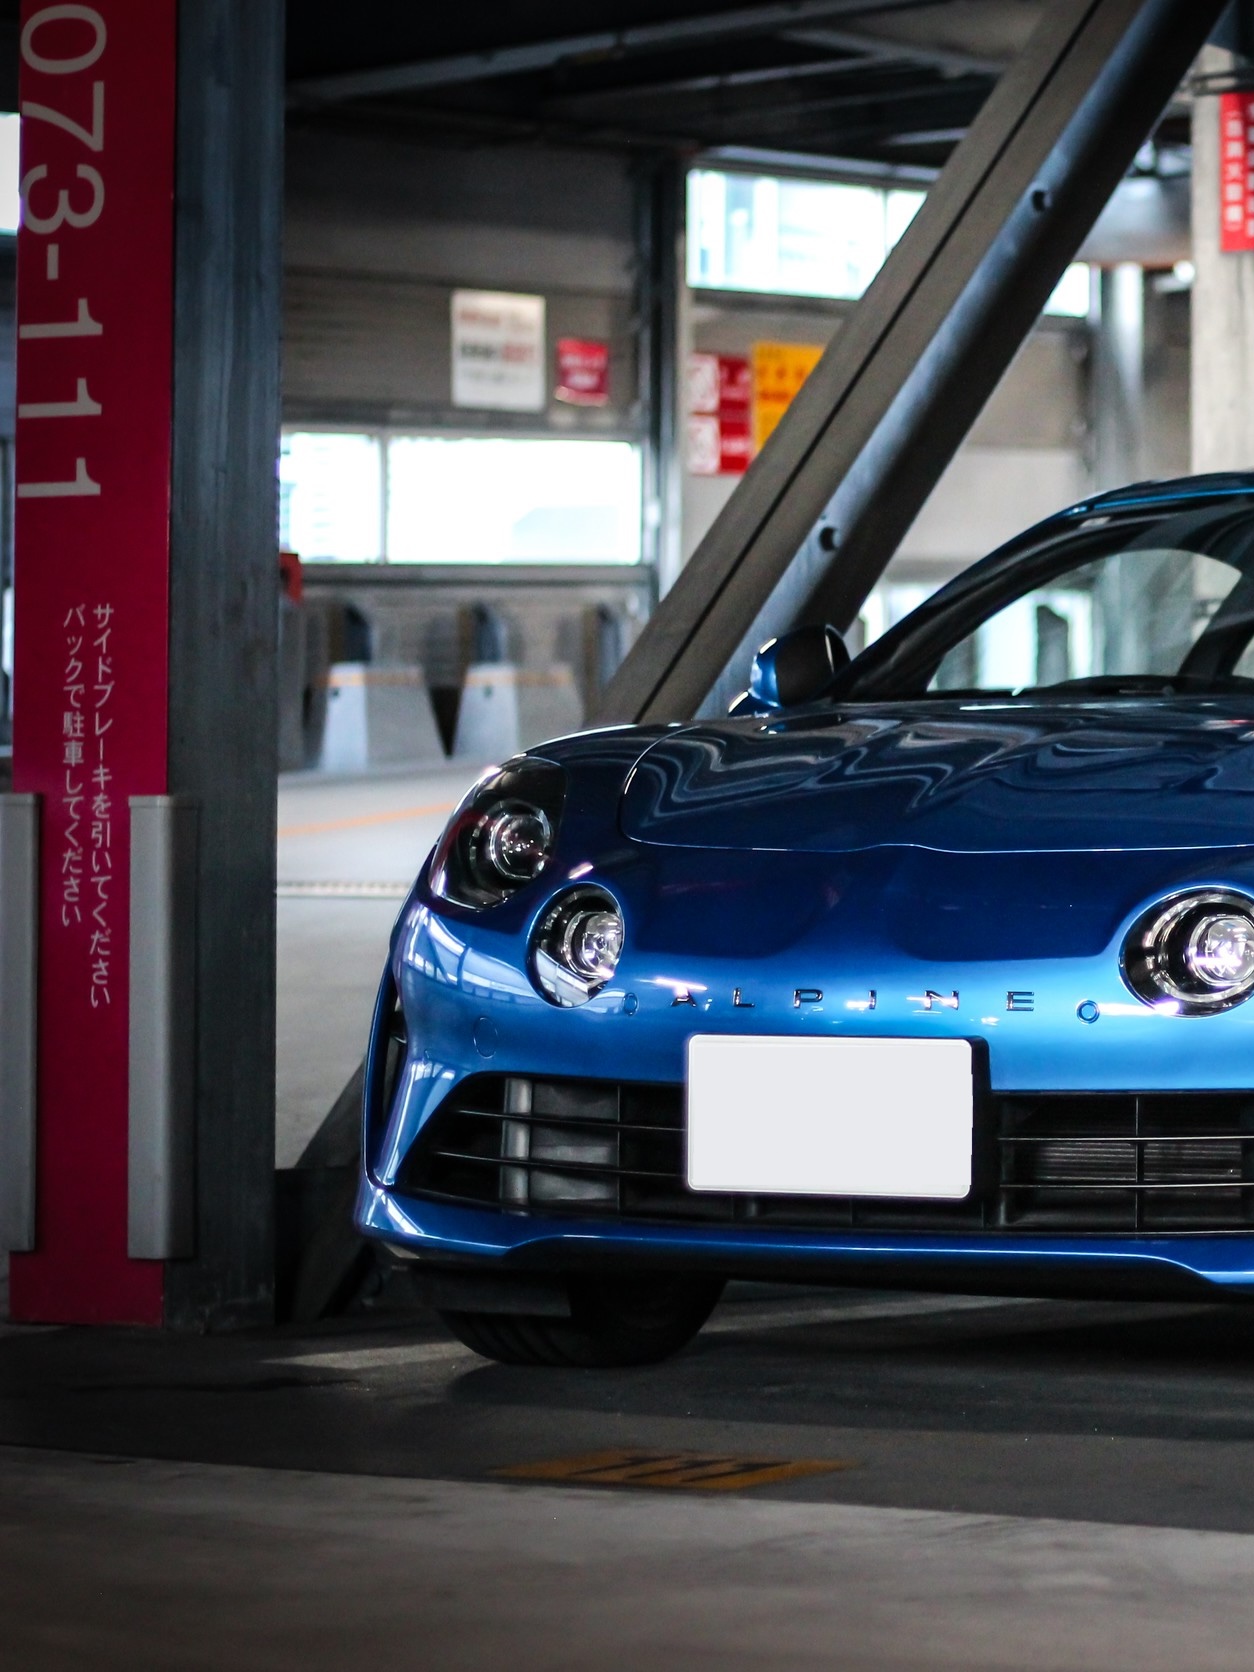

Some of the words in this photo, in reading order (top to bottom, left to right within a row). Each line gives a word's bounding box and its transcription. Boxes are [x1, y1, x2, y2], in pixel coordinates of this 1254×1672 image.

[17, 4, 107, 498] 073-111
[62, 604, 85, 926] バックで駐車してください
[90, 603, 114, 1009] サイドブレーキを引いてください
[670, 987, 1035, 1012] ALPINE
